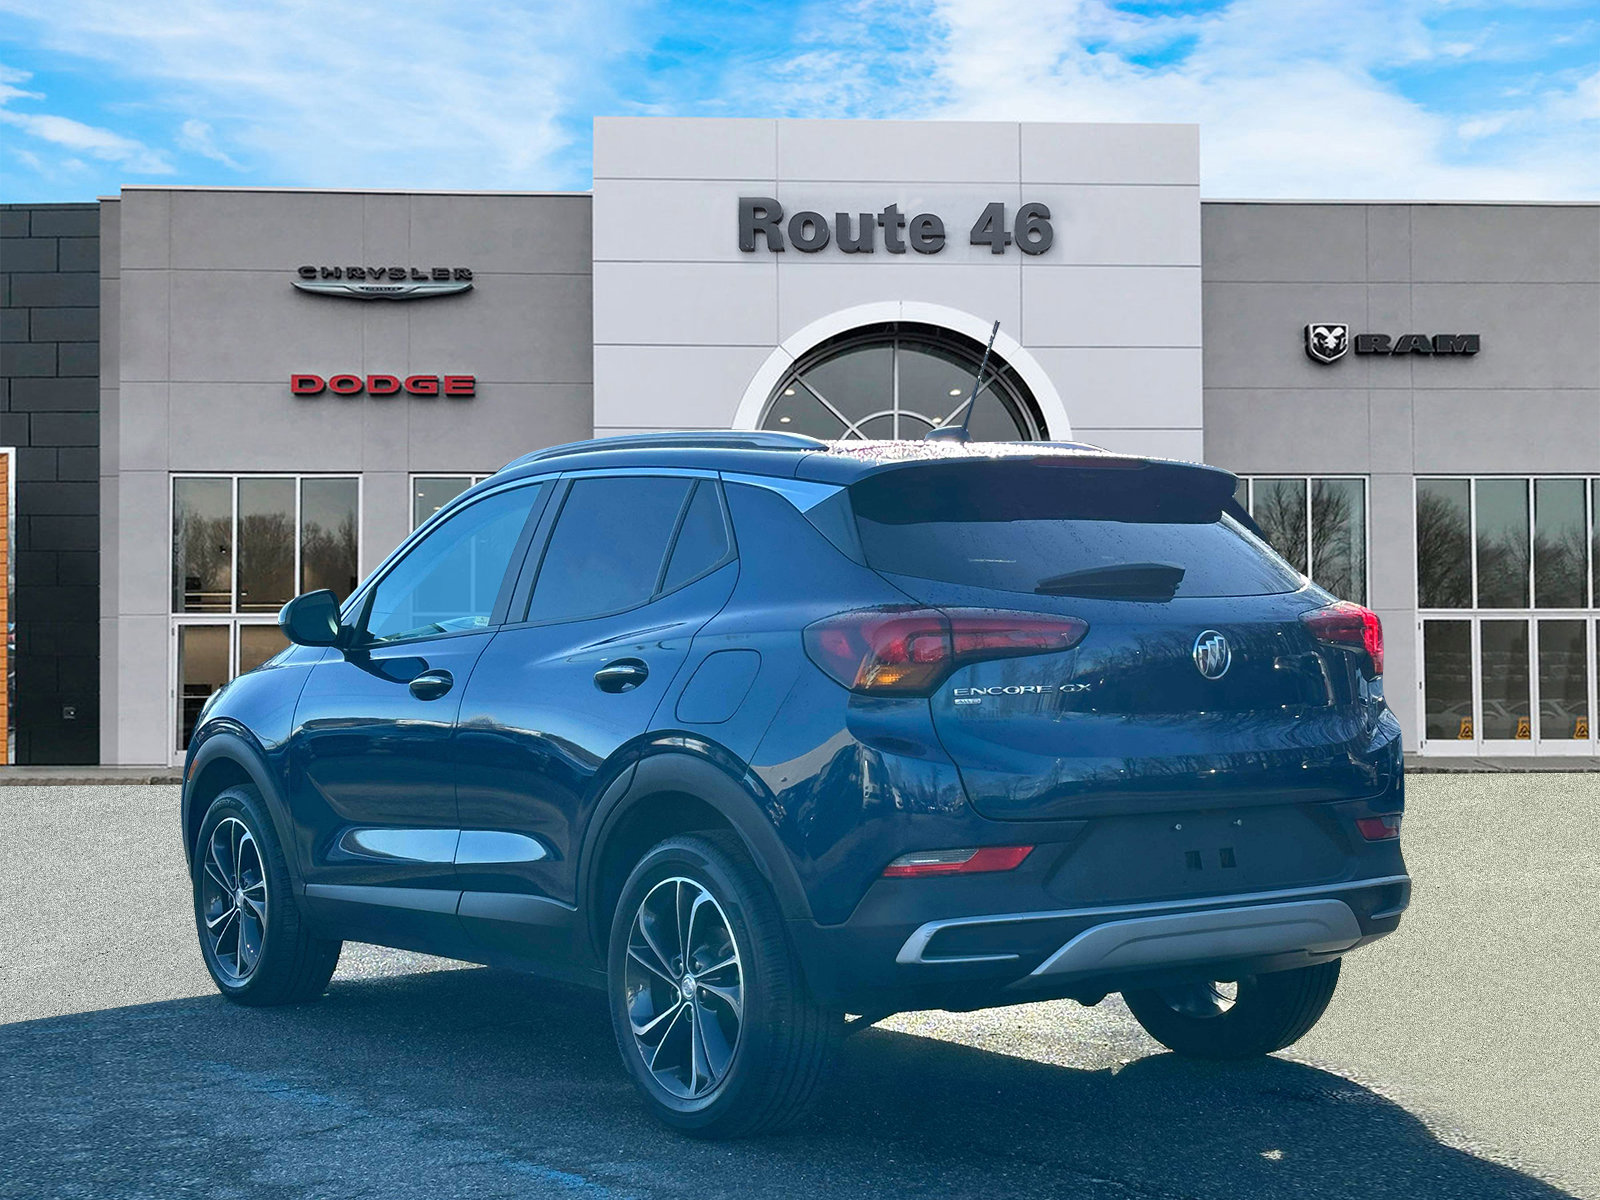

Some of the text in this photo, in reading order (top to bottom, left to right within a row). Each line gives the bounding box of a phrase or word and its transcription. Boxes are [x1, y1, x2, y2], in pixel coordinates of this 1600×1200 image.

[738, 196, 1054, 255] Route 46
[298, 265, 474, 281] CHRYSLER
[1354, 333, 1481, 356] RAM
[290, 374, 477, 397] DODGE
[953, 683, 1092, 697] ENCORE GX
